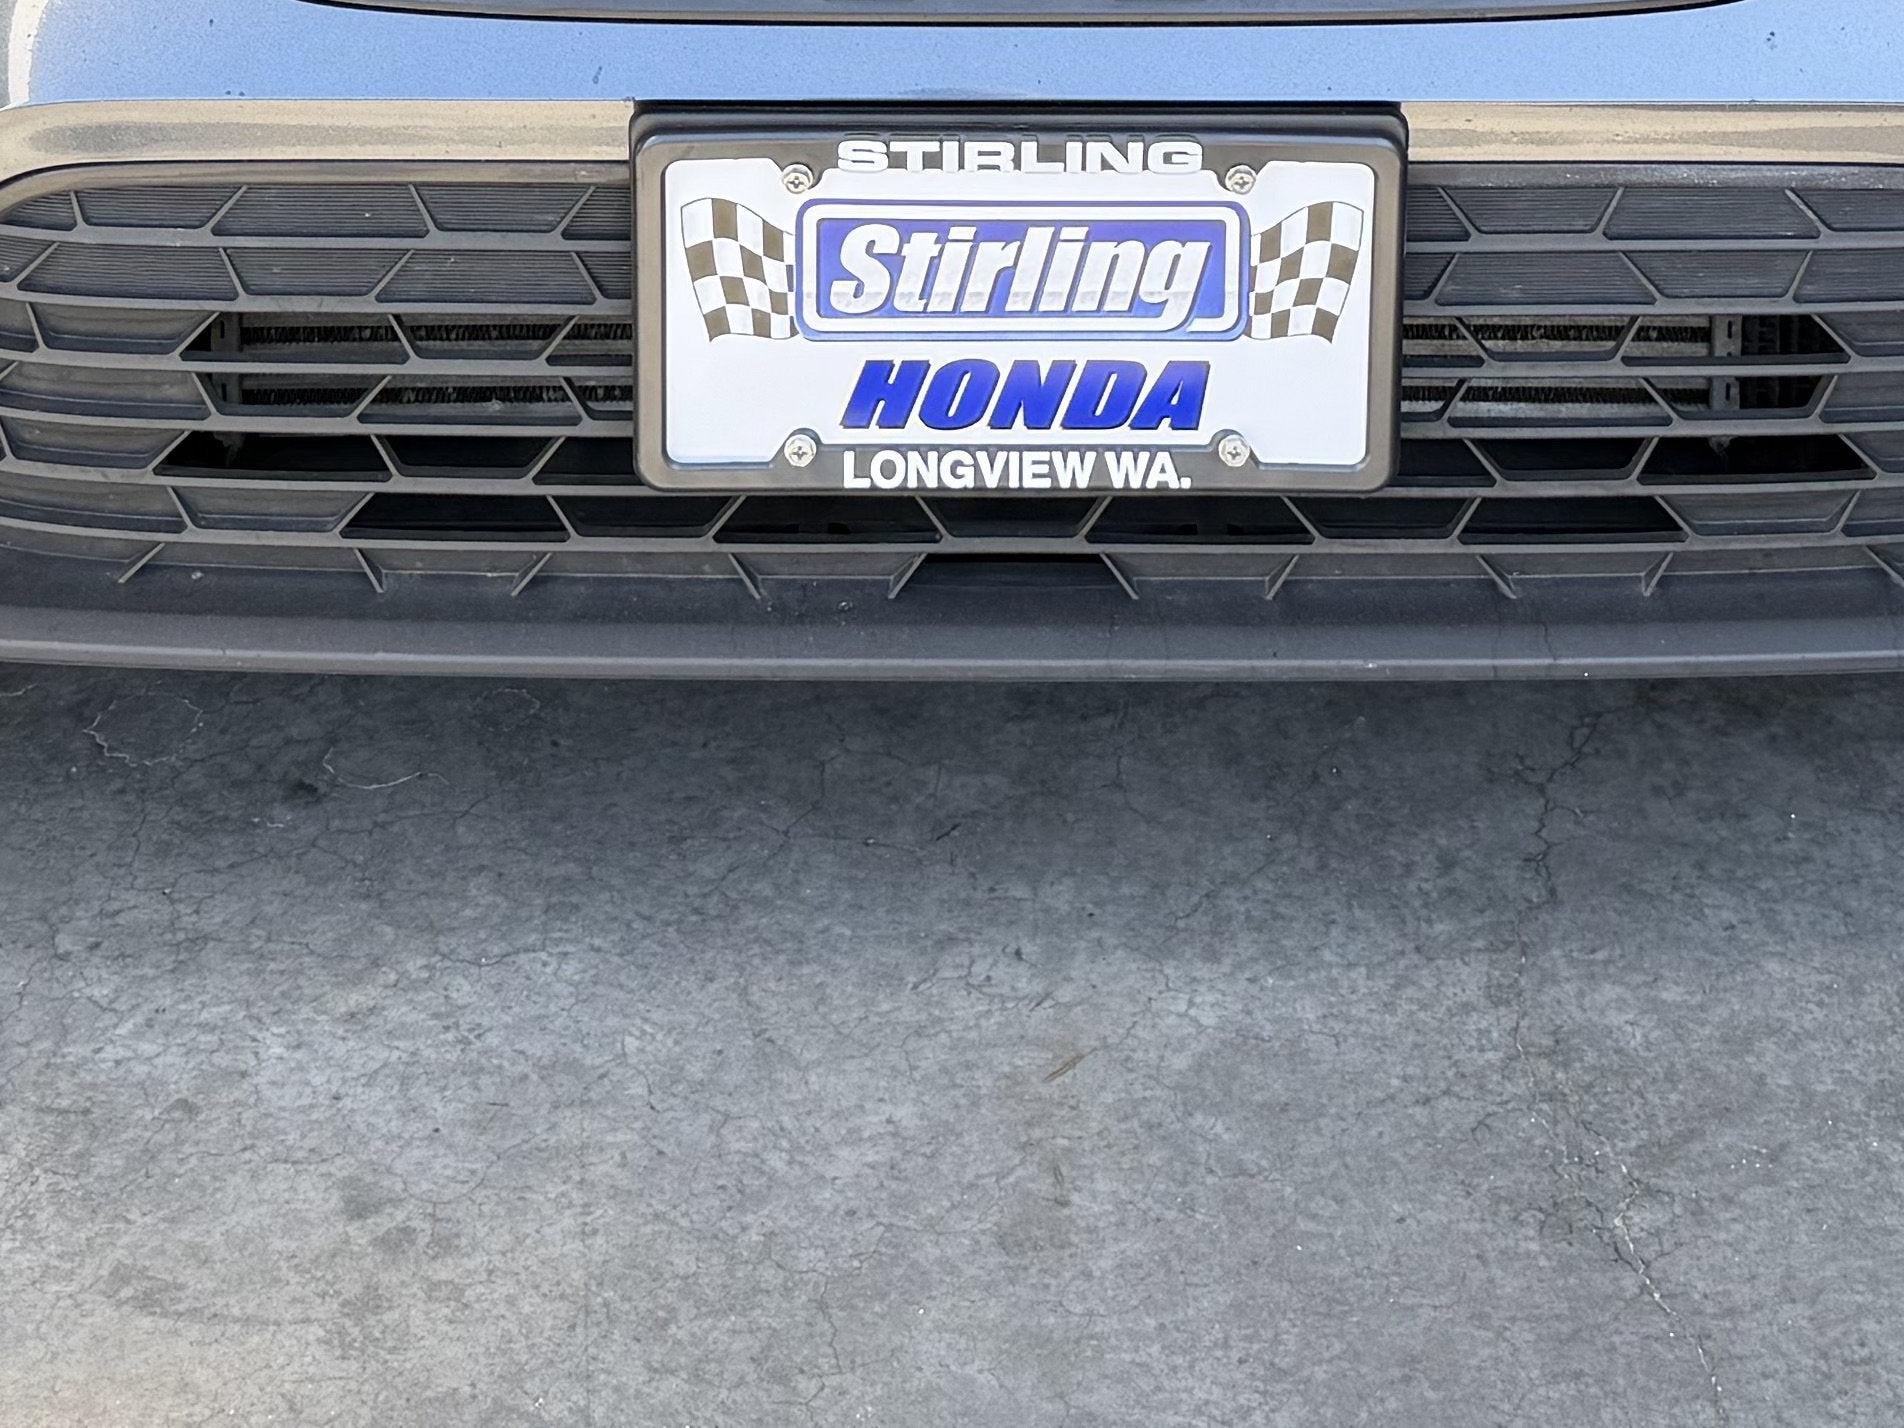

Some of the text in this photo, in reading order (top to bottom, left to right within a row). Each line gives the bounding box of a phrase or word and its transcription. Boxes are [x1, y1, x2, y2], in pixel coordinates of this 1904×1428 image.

[836, 138, 1204, 175] STIRLING
[829, 222, 1212, 320] Stirling
[838, 358, 1211, 432] HONDA
[842, 450, 1192, 490] LONGVIEW WA.
